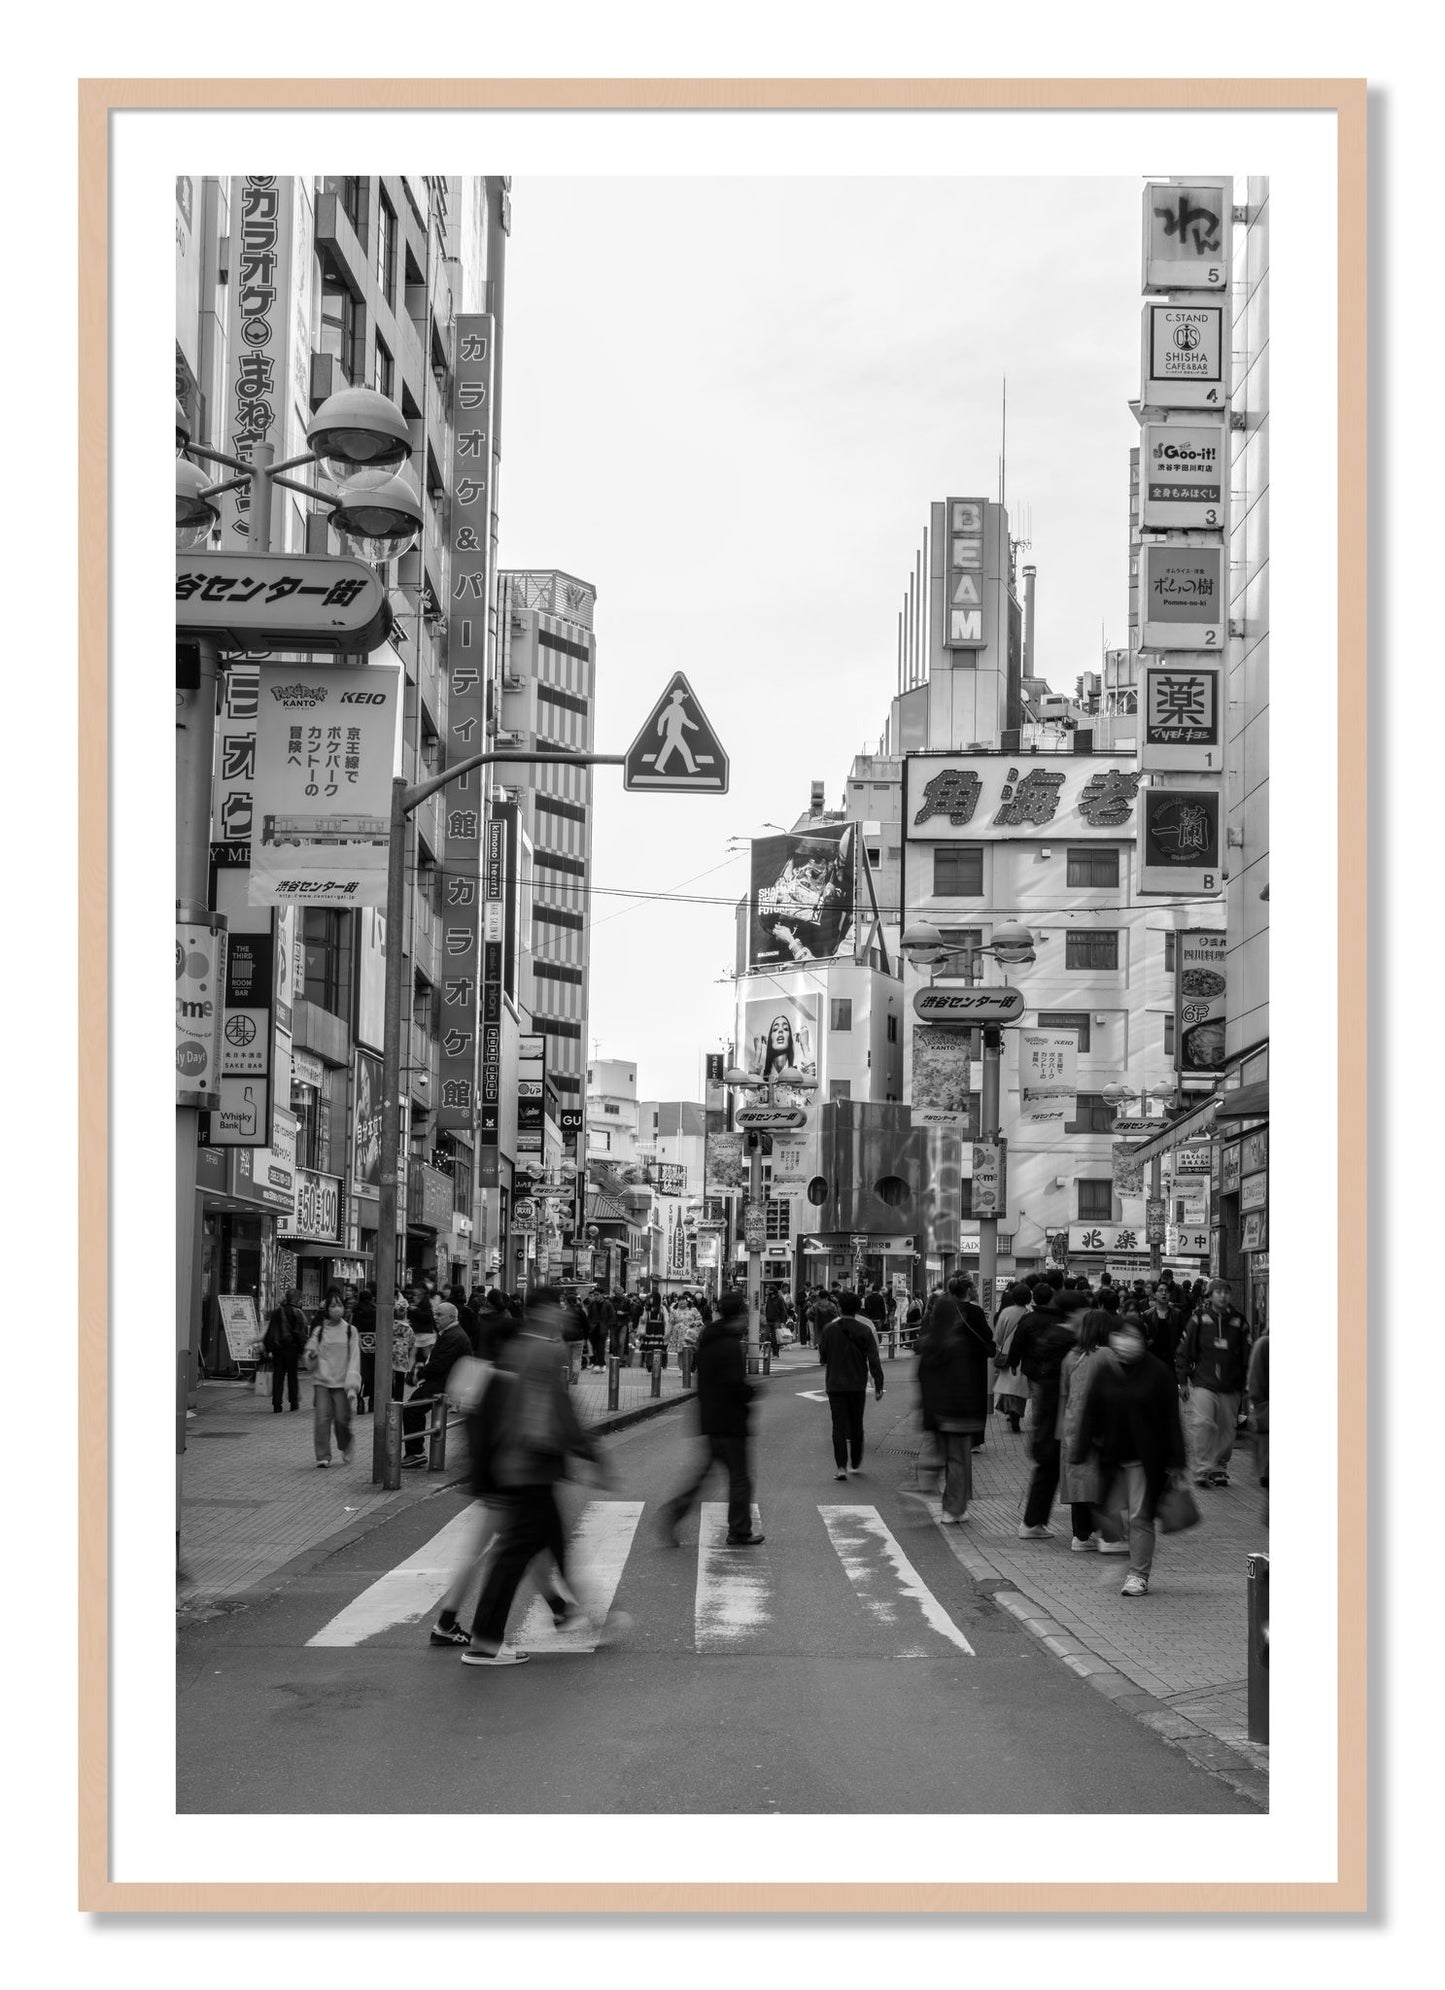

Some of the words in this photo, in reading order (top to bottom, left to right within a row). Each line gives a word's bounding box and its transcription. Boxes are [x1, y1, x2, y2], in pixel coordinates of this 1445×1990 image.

[240, 187, 279, 320] カラオケ
[1208, 269, 1219, 283] 5
[1165, 313, 1208, 323] C.STAND
[1165, 352, 1208, 362] SHISHA
[1165, 363, 1208, 371] CAFE&BAR
[1207, 388, 1218, 403] 4
[1164, 444, 1216, 461] Goo-it!
[1152, 487, 1217, 499] 全身もみほぐし
[1205, 508, 1217, 525] 3
[951, 503, 983, 641] BEAM
[176, 572, 369, 607] 谷センター街
[1205, 630, 1217, 645] 2
[283, 700, 316, 708] KANTO
[340, 691, 387, 705] KEIO
[1156, 676, 1205, 725] 薬
[222, 650, 260, 840] ラオケ
[287, 725, 303, 767] 冒険へ
[304, 726, 321, 797] カントーの
[324, 726, 342, 797] ポケパーク
[344, 727, 361, 784] 京王線で
[1205, 753, 1213, 767] 1
[914, 767, 1144, 827] 角海老
[1151, 805, 1209, 852] 一蘭
[491, 824, 500, 859] kimono
[274, 880, 361, 893] 渋谷センター街
[490, 863, 500, 896] hearts
[1203, 874, 1214, 889] B
[232, 952, 253, 960] THIRD
[1183, 950, 1226, 962] 四川料理
[231, 979, 252, 987] ROOM
[442, 878, 475, 1109] カラオケ館
[920, 996, 1018, 1009] 渋谷センター街
[1182, 1004, 1209, 1023] 6F
[187, 1050, 206, 1064] Day!
[220, 1111, 252, 1123] Whisky
[562, 1115, 582, 1126] GU
[219, 1121, 239, 1129] Bank
[1081, 1229, 1139, 1249] 兆楽
